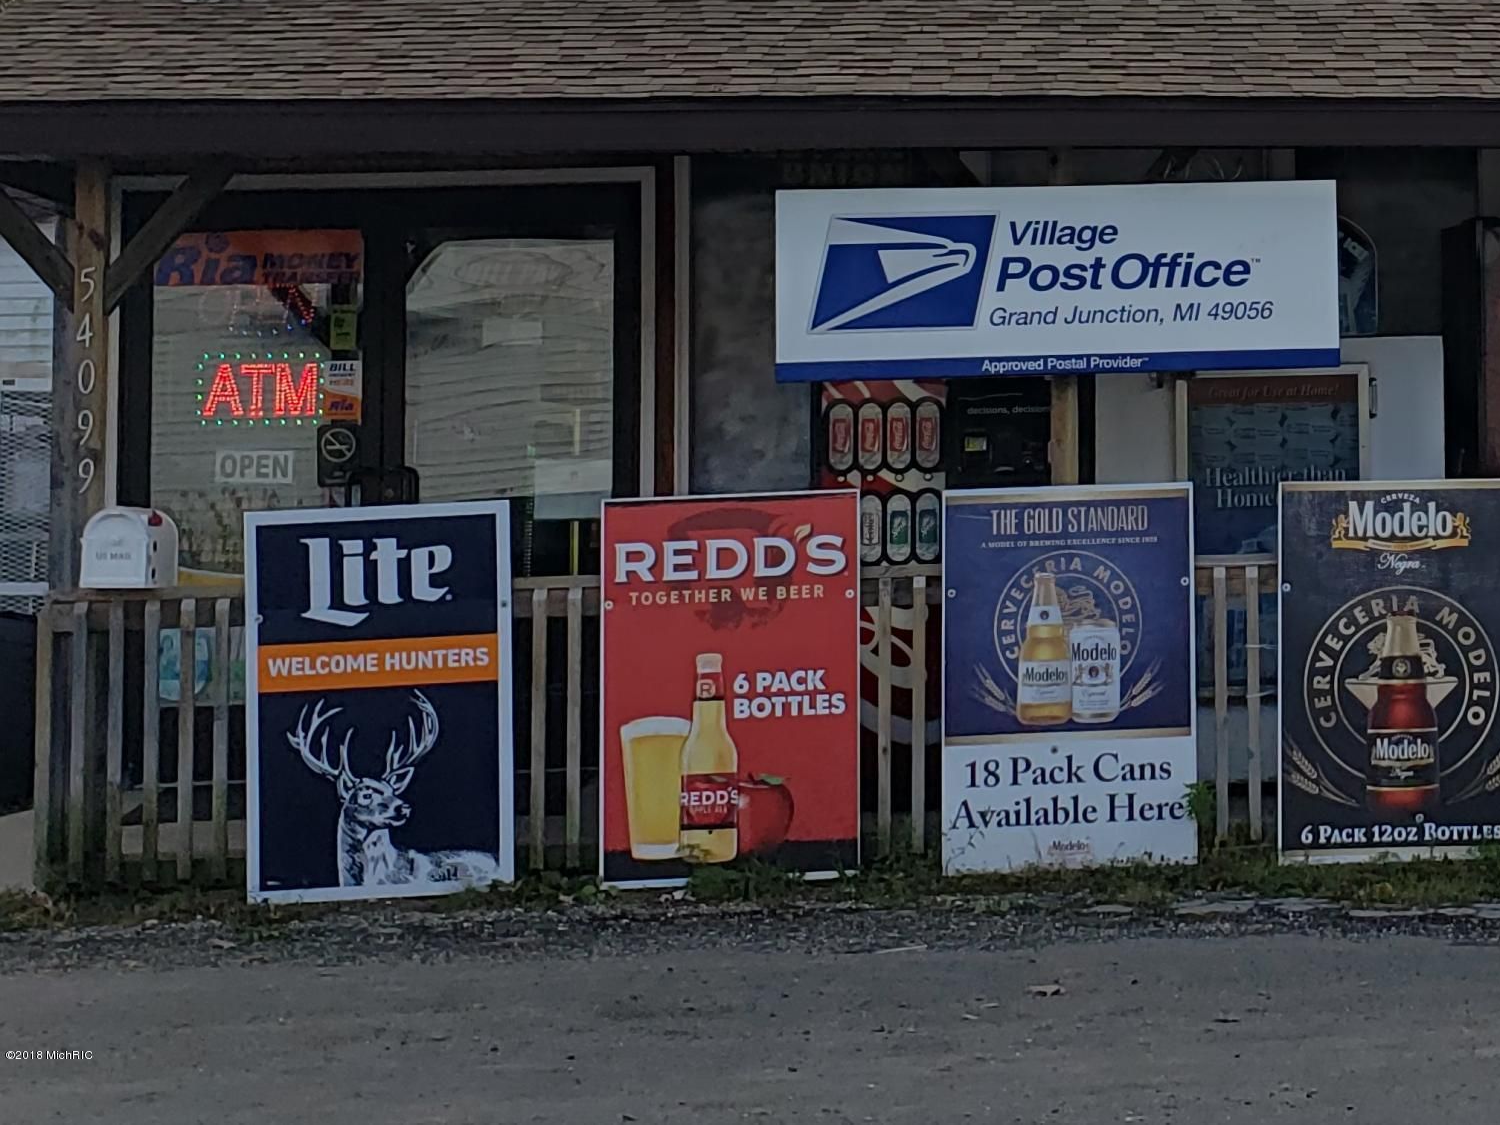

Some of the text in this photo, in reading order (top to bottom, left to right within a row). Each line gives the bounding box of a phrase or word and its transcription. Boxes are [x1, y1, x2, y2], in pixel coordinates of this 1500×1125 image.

[1009, 220, 1118, 251] Village
[157, 231, 257, 285] Ria
[263, 253, 360, 269] MONEY
[996, 252, 1251, 292] Post Office
[989, 301, 1274, 326] Grand Junction, MI 49056
[329, 363, 356, 372] BILL
[982, 357, 1143, 373] Approved Postal Provider
[203, 363, 318, 417] ATM
[220, 454, 289, 479] OPEN
[1303, 464, 1346, 481] than
[1381, 492, 1421, 504] CERVEZA
[990, 505, 1148, 535] THE GOLD STANDARD
[1348, 501, 1453, 538] Modelo
[613, 525, 848, 583] REDD'S
[1029, 539, 1066, 547] BREWING
[1067, 537, 1117, 546] EXCELLENCE
[1117, 536, 1140, 544] SINCE
[1377, 552, 1421, 575] Negra
[300, 537, 453, 627] Lite
[629, 584, 825, 606] TOGETHER WE BEER
[1000, 556, 1082, 660] CERVECERIA
[1093, 565, 1136, 655] MODELO
[268, 646, 490, 677] WELCOME HUNTERS
[1071, 642, 1117, 662] Modelo
[1313, 595, 1420, 728] CERVECERIA
[1024, 666, 1065, 682] Modelo
[1435, 606, 1492, 726] MODELO
[733, 669, 826, 694] 6 PACK
[733, 692, 846, 720] BOTTLES
[1376, 737, 1430, 760] Modelo
[965, 752, 1172, 788] 18 Pack Cans
[680, 787, 739, 806] REDD'S
[950, 792, 1185, 830] Available Here
[1052, 839, 1086, 851] Modelo
[1301, 825, 1313, 844] 6
[1319, 825, 1367, 844] PACK
